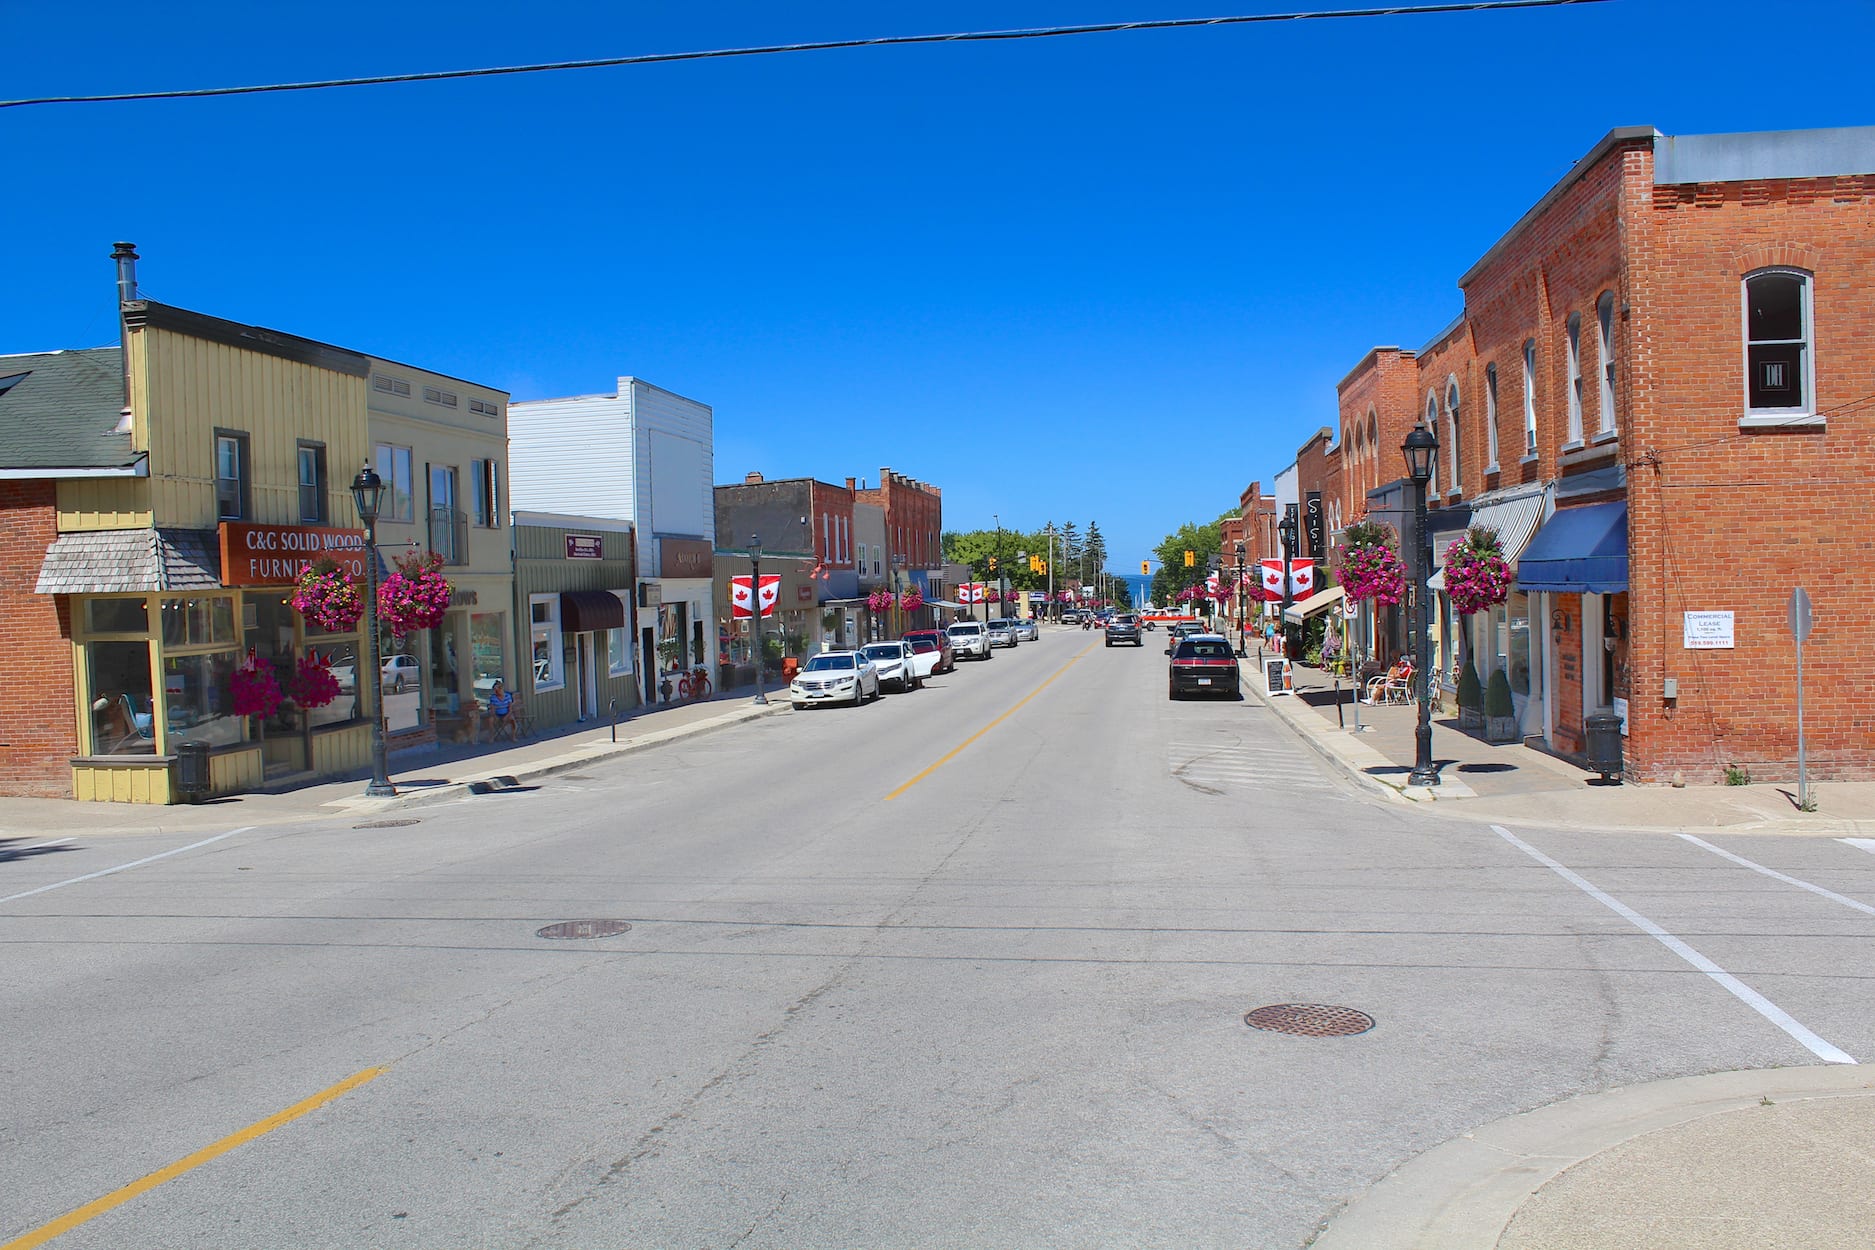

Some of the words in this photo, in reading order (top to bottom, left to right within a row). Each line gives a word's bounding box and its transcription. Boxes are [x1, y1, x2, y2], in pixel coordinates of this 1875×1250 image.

[246, 530, 277, 550] C&G
[281, 532, 320, 551] SOLID
[323, 534, 363, 552] WOOD
